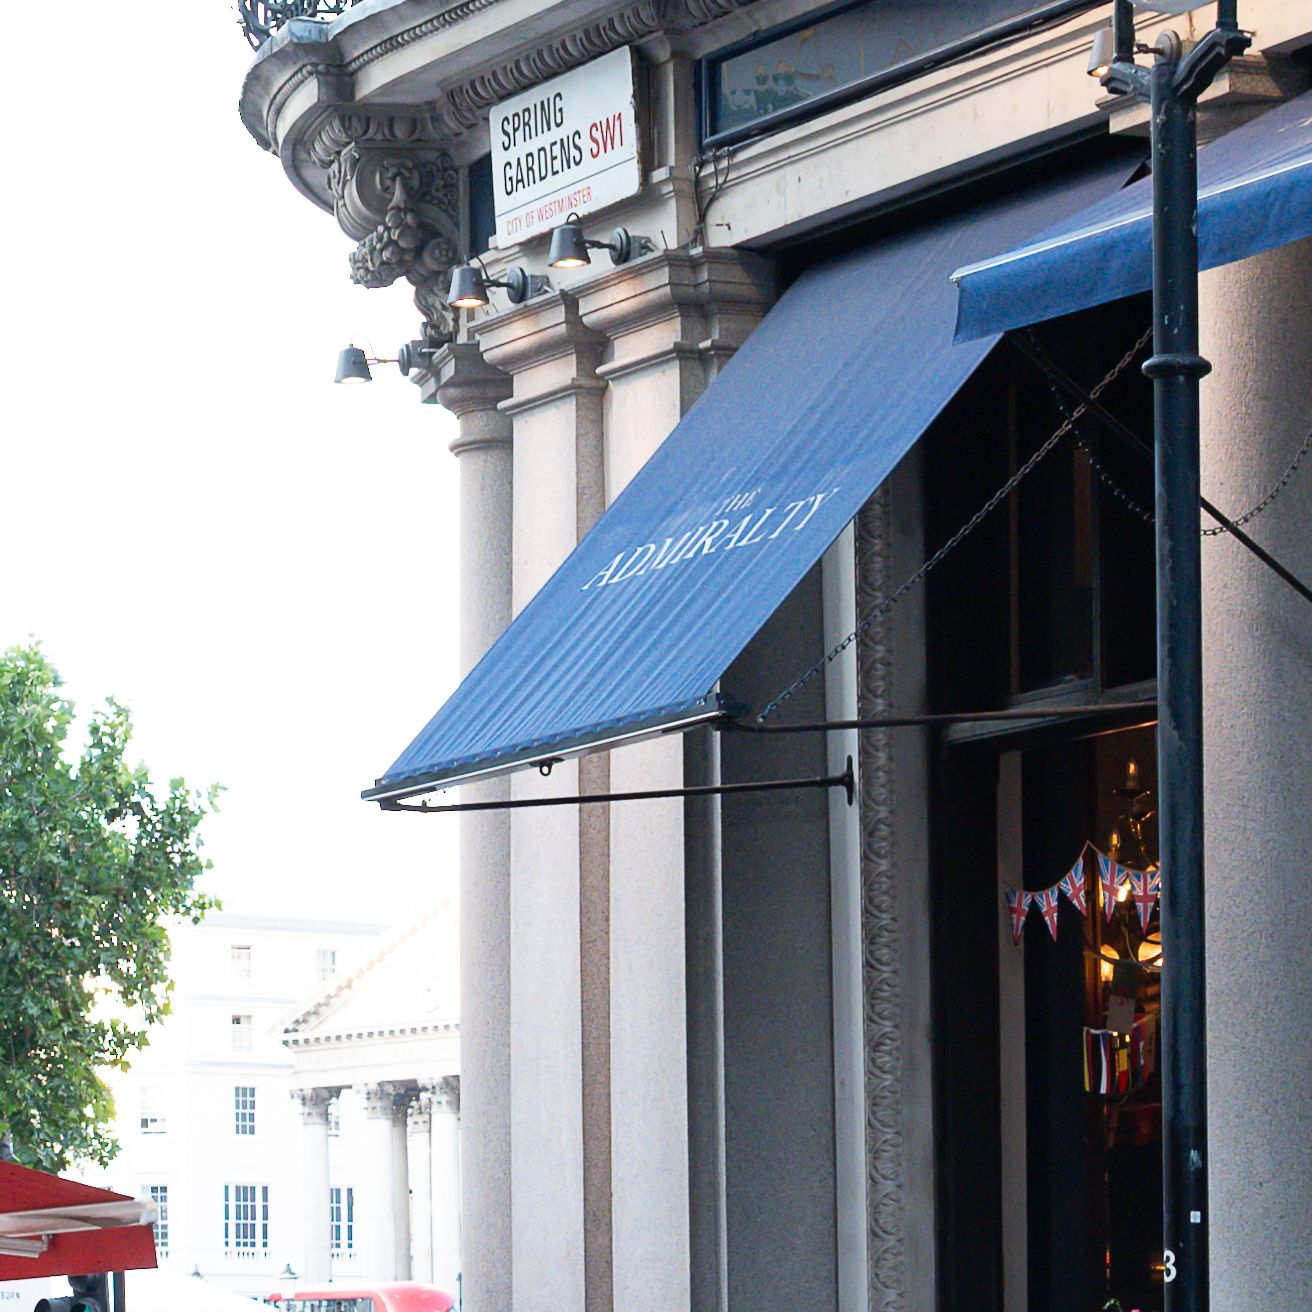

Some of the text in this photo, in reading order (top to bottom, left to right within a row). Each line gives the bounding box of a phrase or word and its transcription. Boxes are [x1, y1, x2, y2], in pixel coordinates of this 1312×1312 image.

[501, 92, 564, 151] SPRING
[503, 112, 623, 196] GARDENS SW1
[506, 186, 593, 236] CITY OF WESTMINSTER
[715, 488, 761, 517] THE
[580, 487, 840, 591] ADMIRALTY
